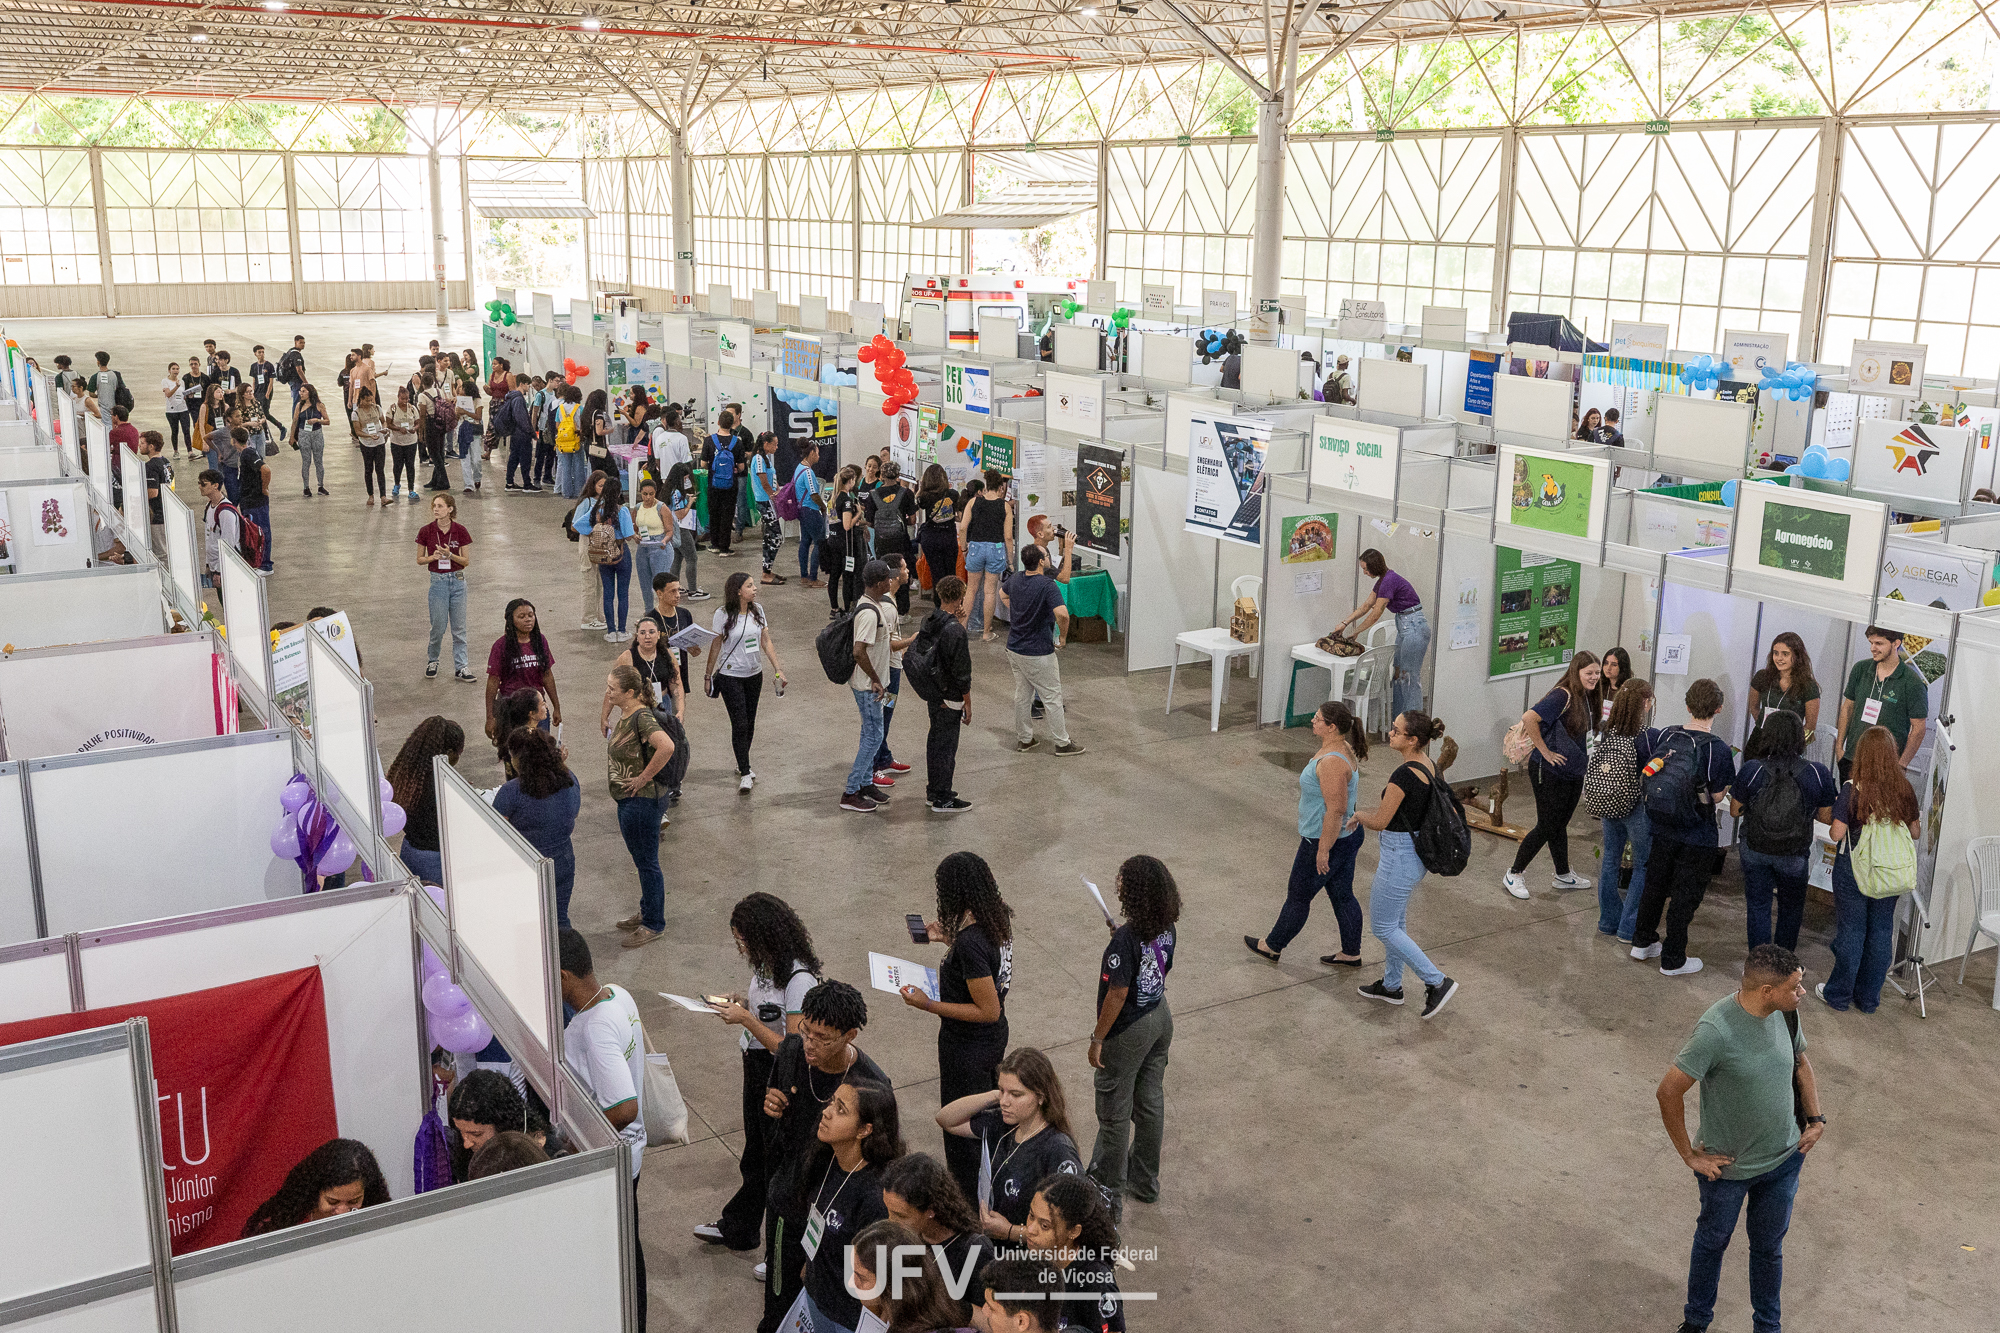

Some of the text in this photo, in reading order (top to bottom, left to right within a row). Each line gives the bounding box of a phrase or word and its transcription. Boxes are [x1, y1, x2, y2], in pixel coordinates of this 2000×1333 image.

[1646, 123, 1669, 132] SAÍDA
[785, 350, 820, 366] EXECUTIV
[946, 364, 963, 385] PET
[1200, 436, 1213, 446] UFV
[1319, 436, 1383, 459] SERVIÇO SOCIAL
[1196, 465, 1219, 478] ELÉTRICA
[1197, 456, 1223, 468] ENGENHARIA
[1196, 506, 1217, 517] CONTATOS
[1774, 528, 1834, 551] Agronegócio
[1902, 565, 1958, 584] AGREGAR
[75, 734, 104, 754] PALHE
[893, 966, 901, 988] MOSTRA
[168, 1173, 218, 1204] Júnior
